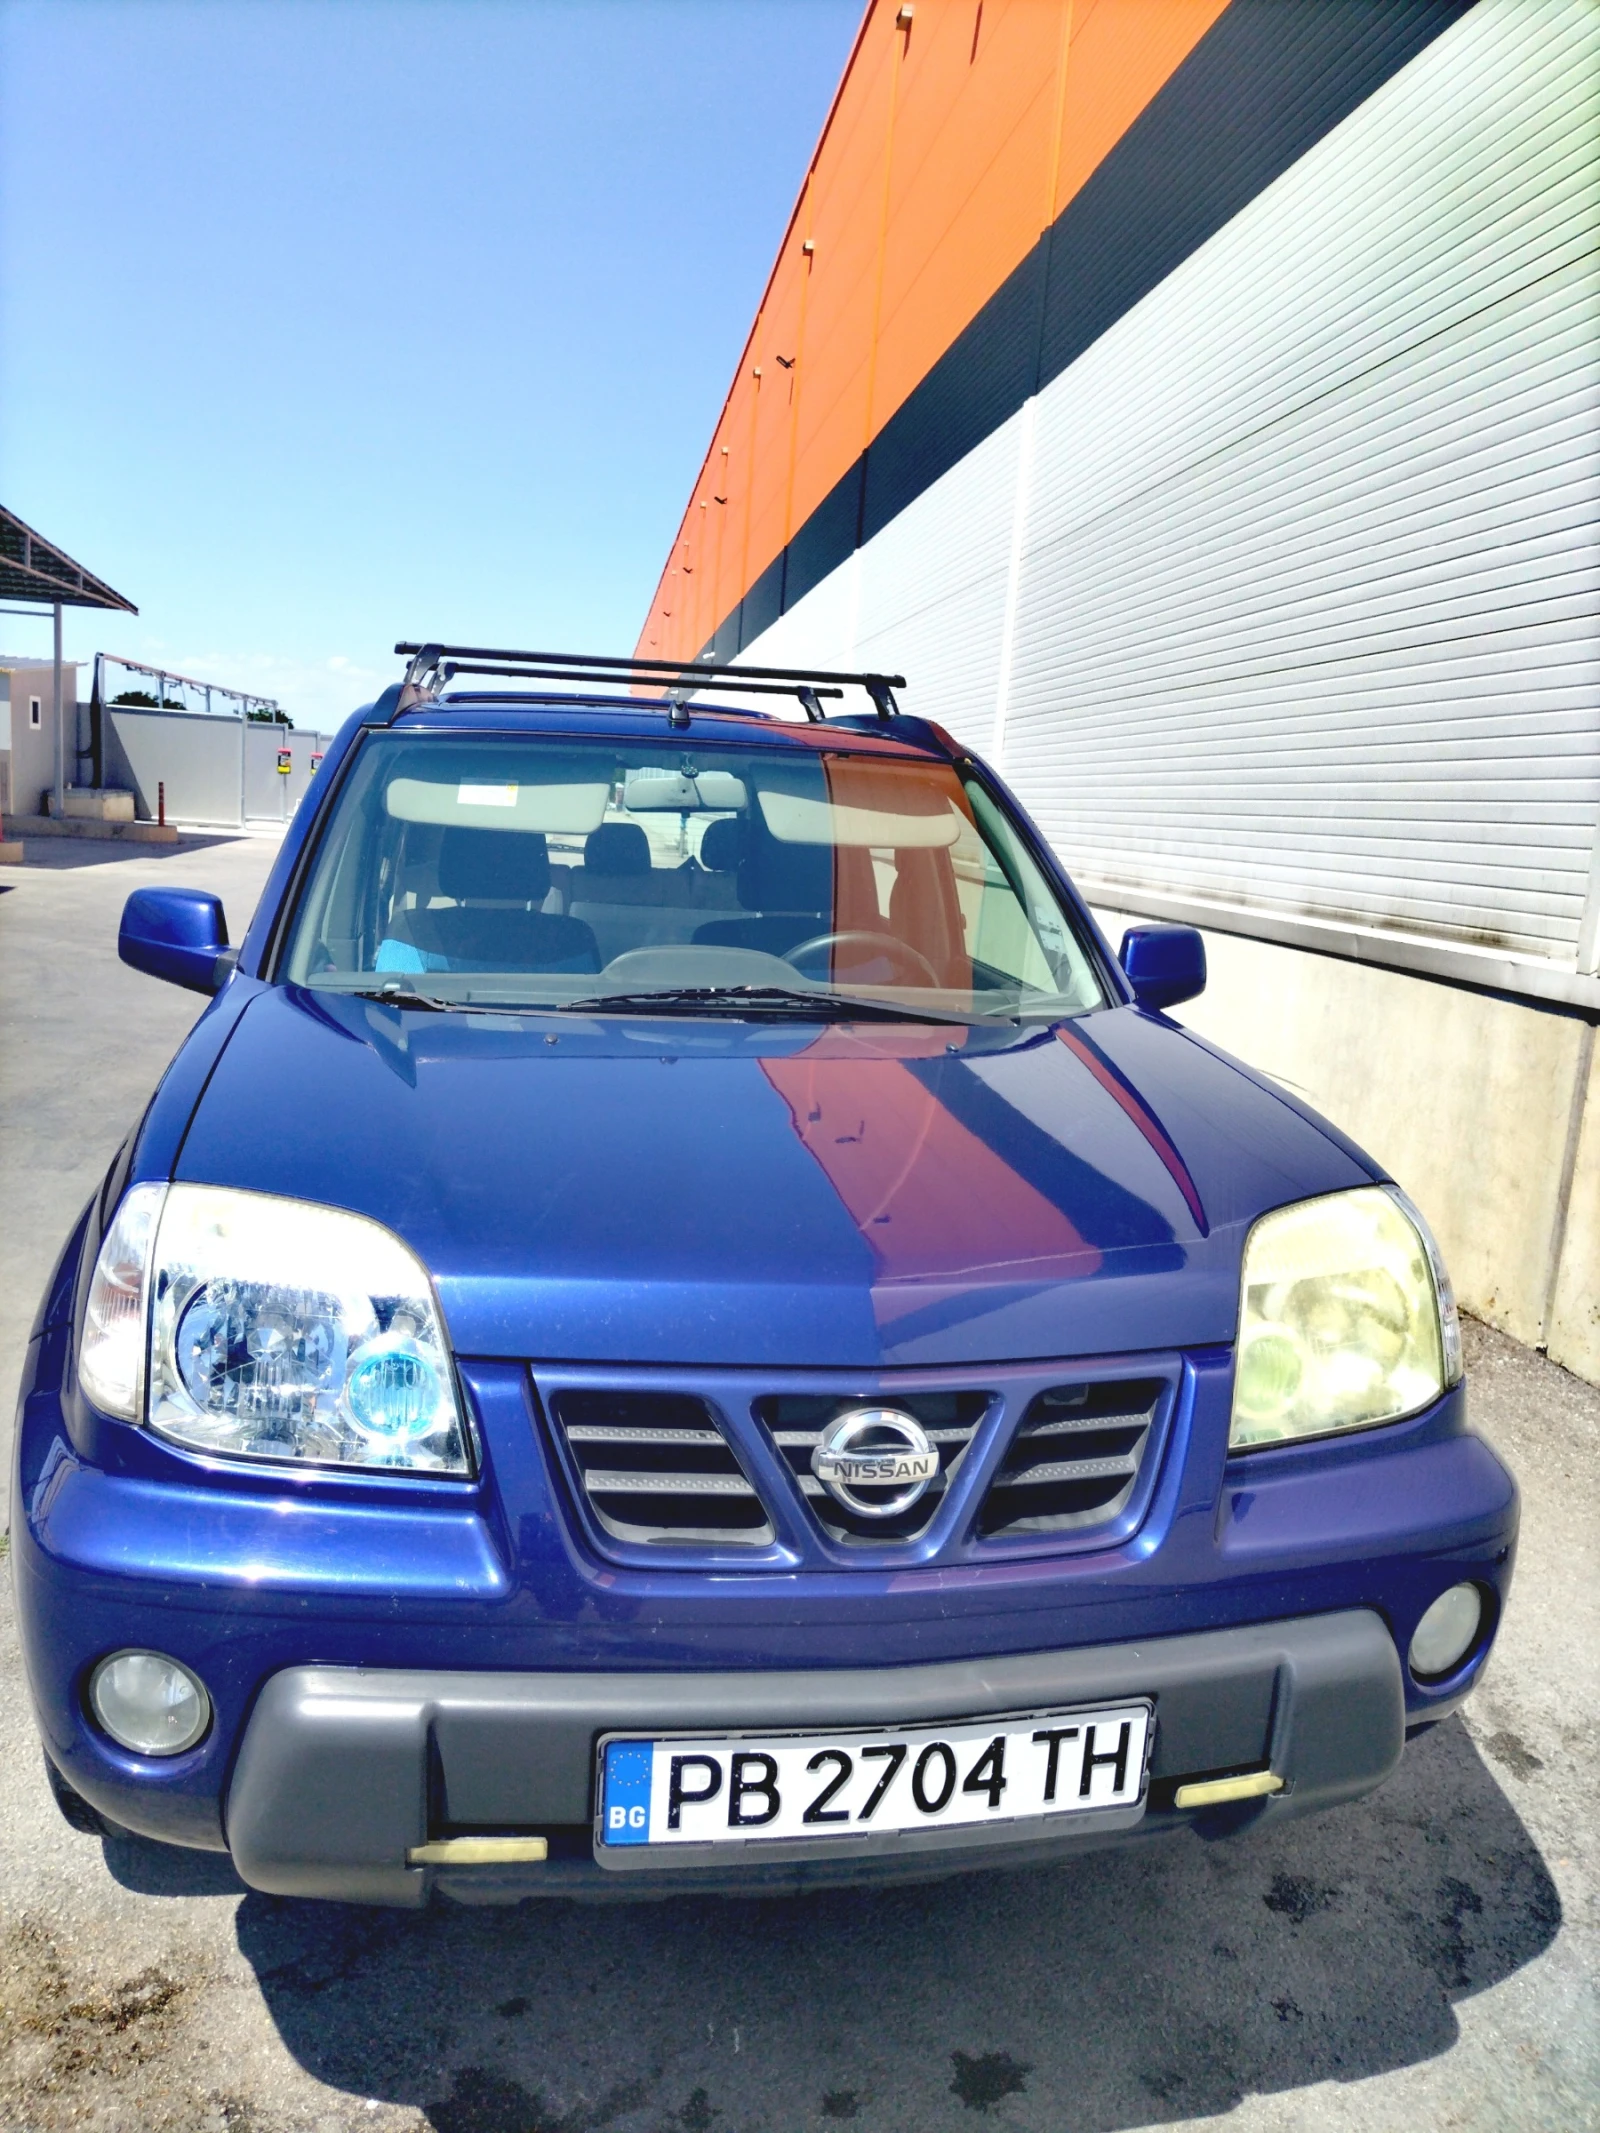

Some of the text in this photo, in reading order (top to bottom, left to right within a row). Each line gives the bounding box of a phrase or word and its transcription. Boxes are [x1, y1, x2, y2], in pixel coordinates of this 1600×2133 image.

[834, 1459, 929, 1479] NISSAN
[667, 1721, 1132, 1829] PB 2704 TH
[609, 1806, 646, 1829] BG
